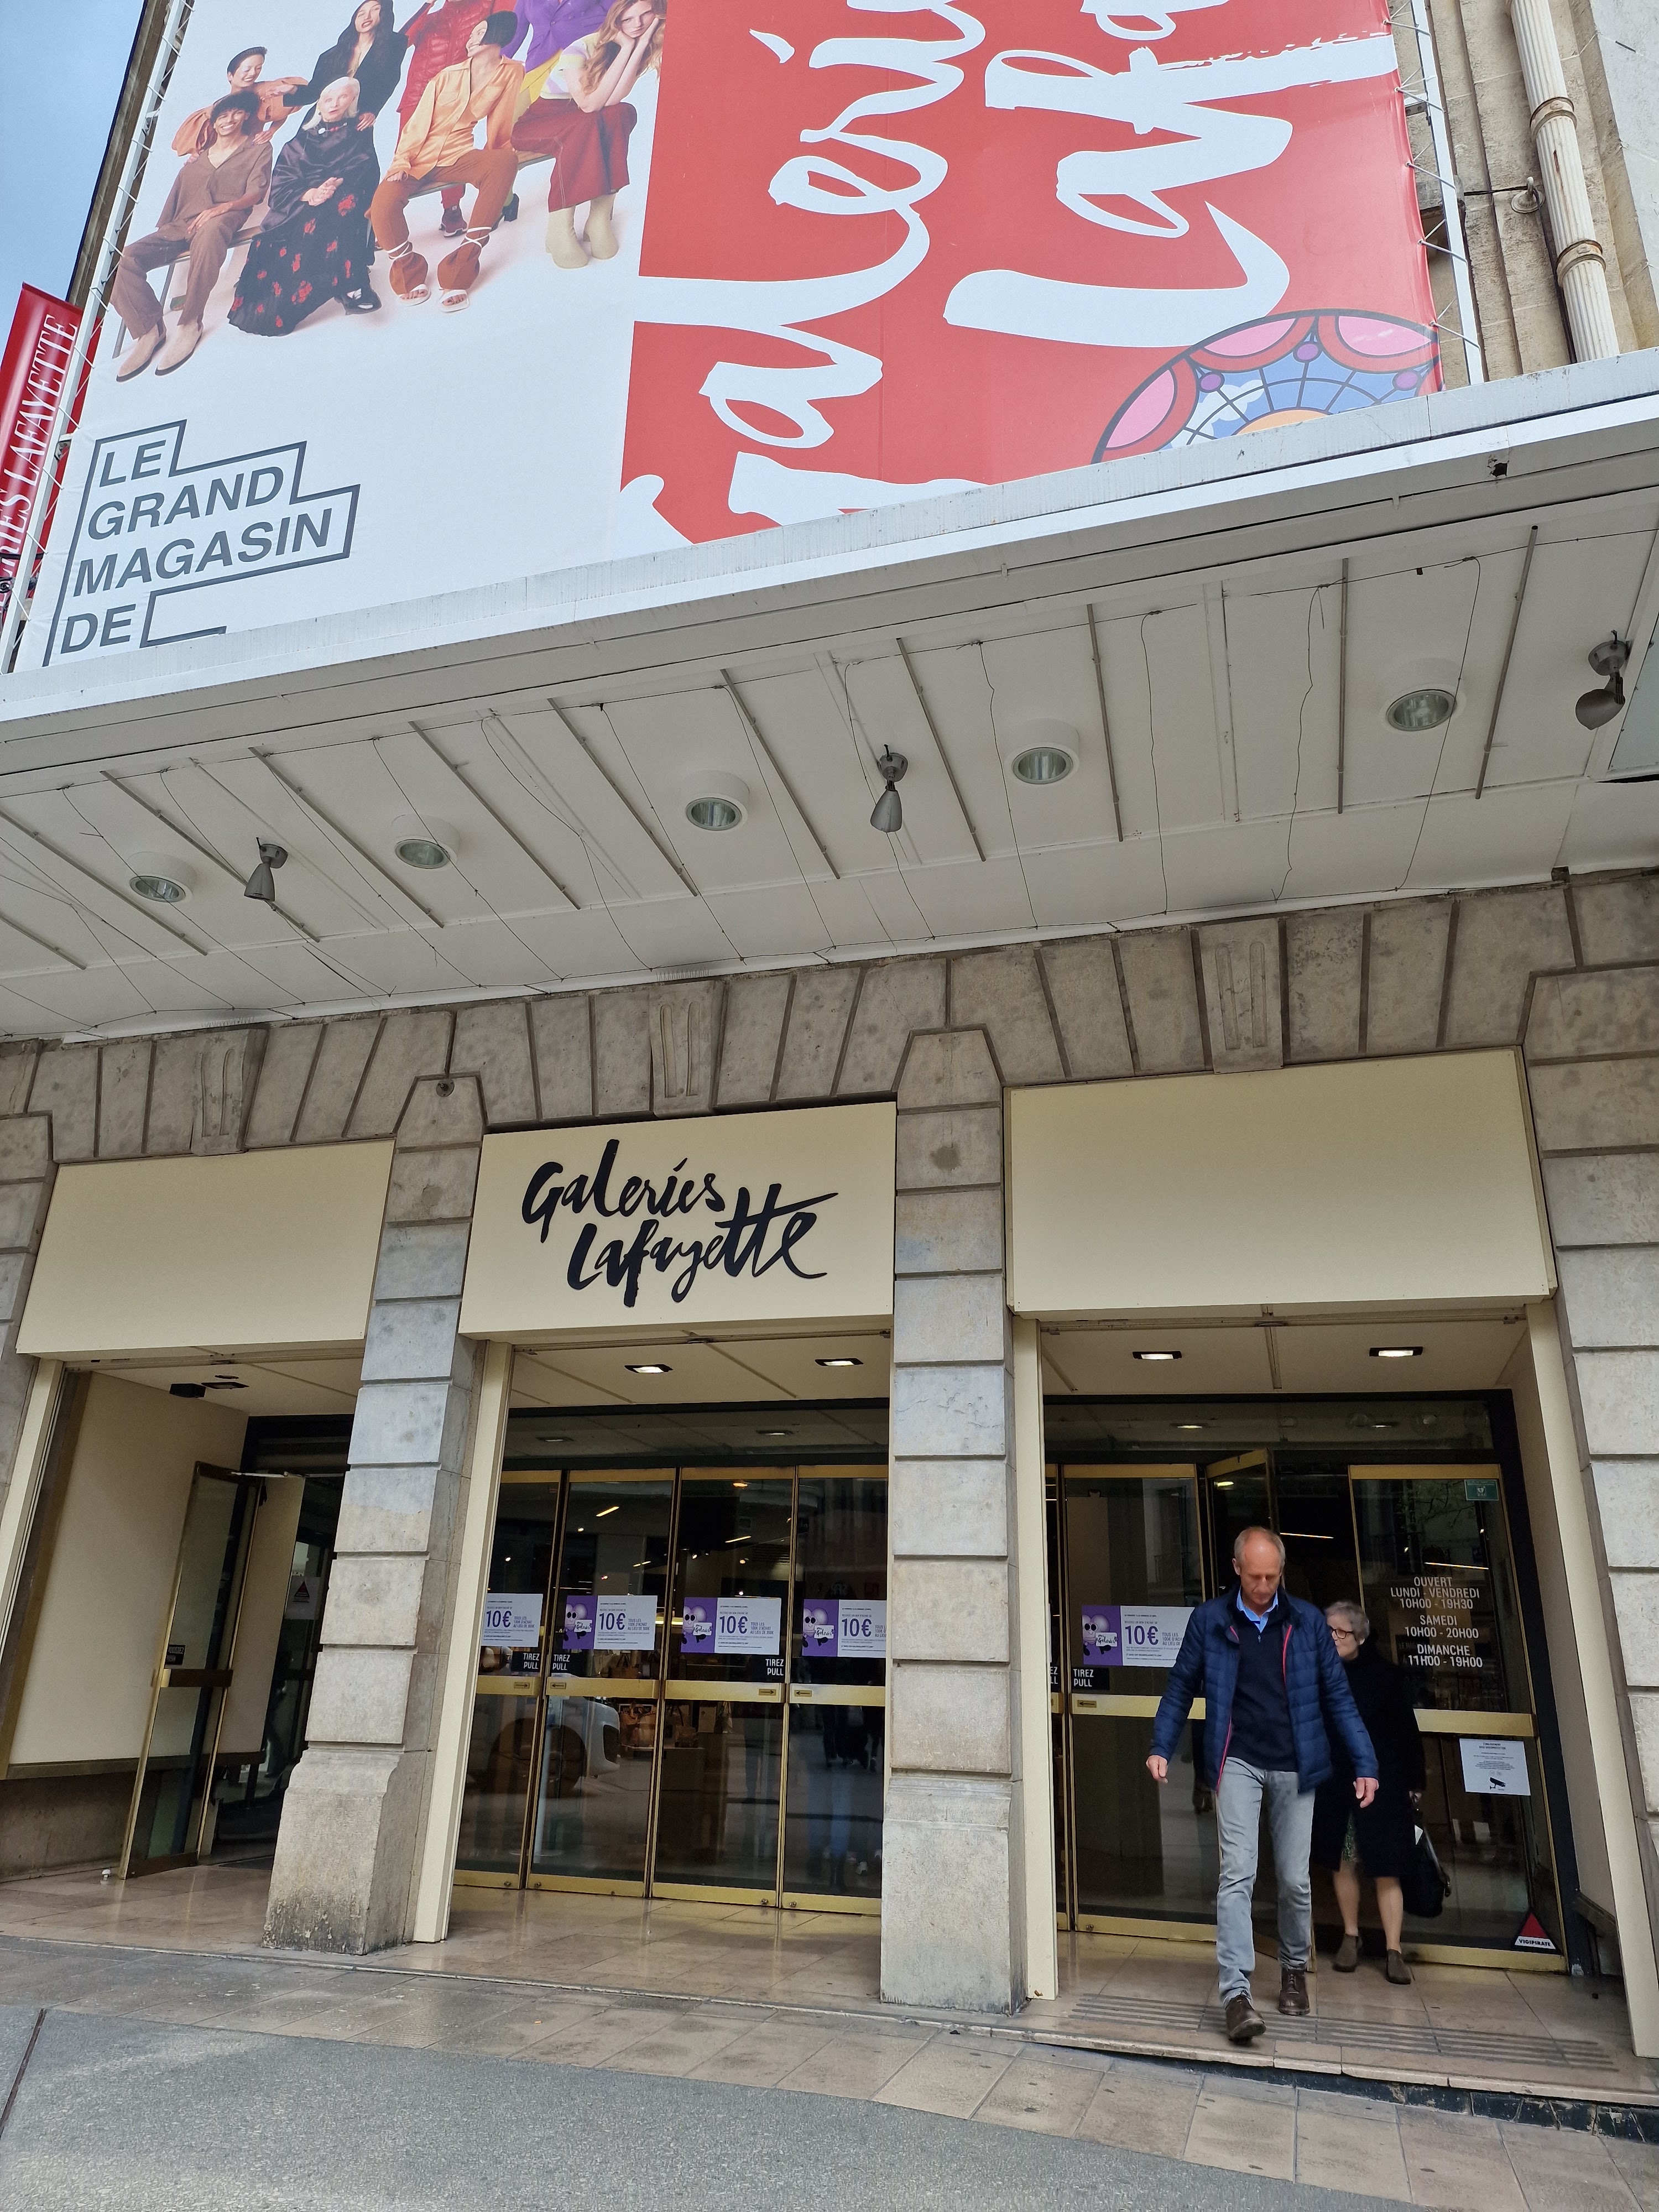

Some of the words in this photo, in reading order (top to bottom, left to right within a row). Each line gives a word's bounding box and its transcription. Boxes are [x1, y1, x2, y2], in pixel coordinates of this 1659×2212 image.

[4, 314, 77, 486] LAFAYETTE
[100, 440, 166, 487] LE
[88, 466, 284, 540] GRAND
[73, 508, 332, 597] MAGASIN
[60, 603, 136, 654] DE
[522, 1139, 725, 1243] Galeries
[567, 1183, 839, 1308] Lafayette
[1413, 1576, 1452, 1587] OUVERT
[1390, 1587, 1420, 1598] LUNDI
[1429, 1588, 1480, 1599] VENDREDI
[1400, 1598, 1431, 1609] 10H00
[1441, 1599, 1473, 1609] 19H30
[487, 1610, 512, 1627] 10€
[599, 1613, 625, 1630] 10€
[719, 1615, 748, 1634] 10€
[1420, 1615, 1457, 1626] SAMEDI
[842, 1618, 872, 1637] 10€
[1125, 1625, 1159, 1645] 10€
[1405, 1626, 1437, 1637] 10H00
[1446, 1627, 1479, 1639] 20H00
[1417, 1644, 1470, 1656] DIMANCHE
[1408, 1655, 1441, 1666] 11H00
[1450, 1656, 1483, 1668] 19H00
[768, 1667, 784, 1676] PULL
[1073, 1669, 1094, 1677] TIREZ
[1073, 1678, 1092, 1687] PULL
